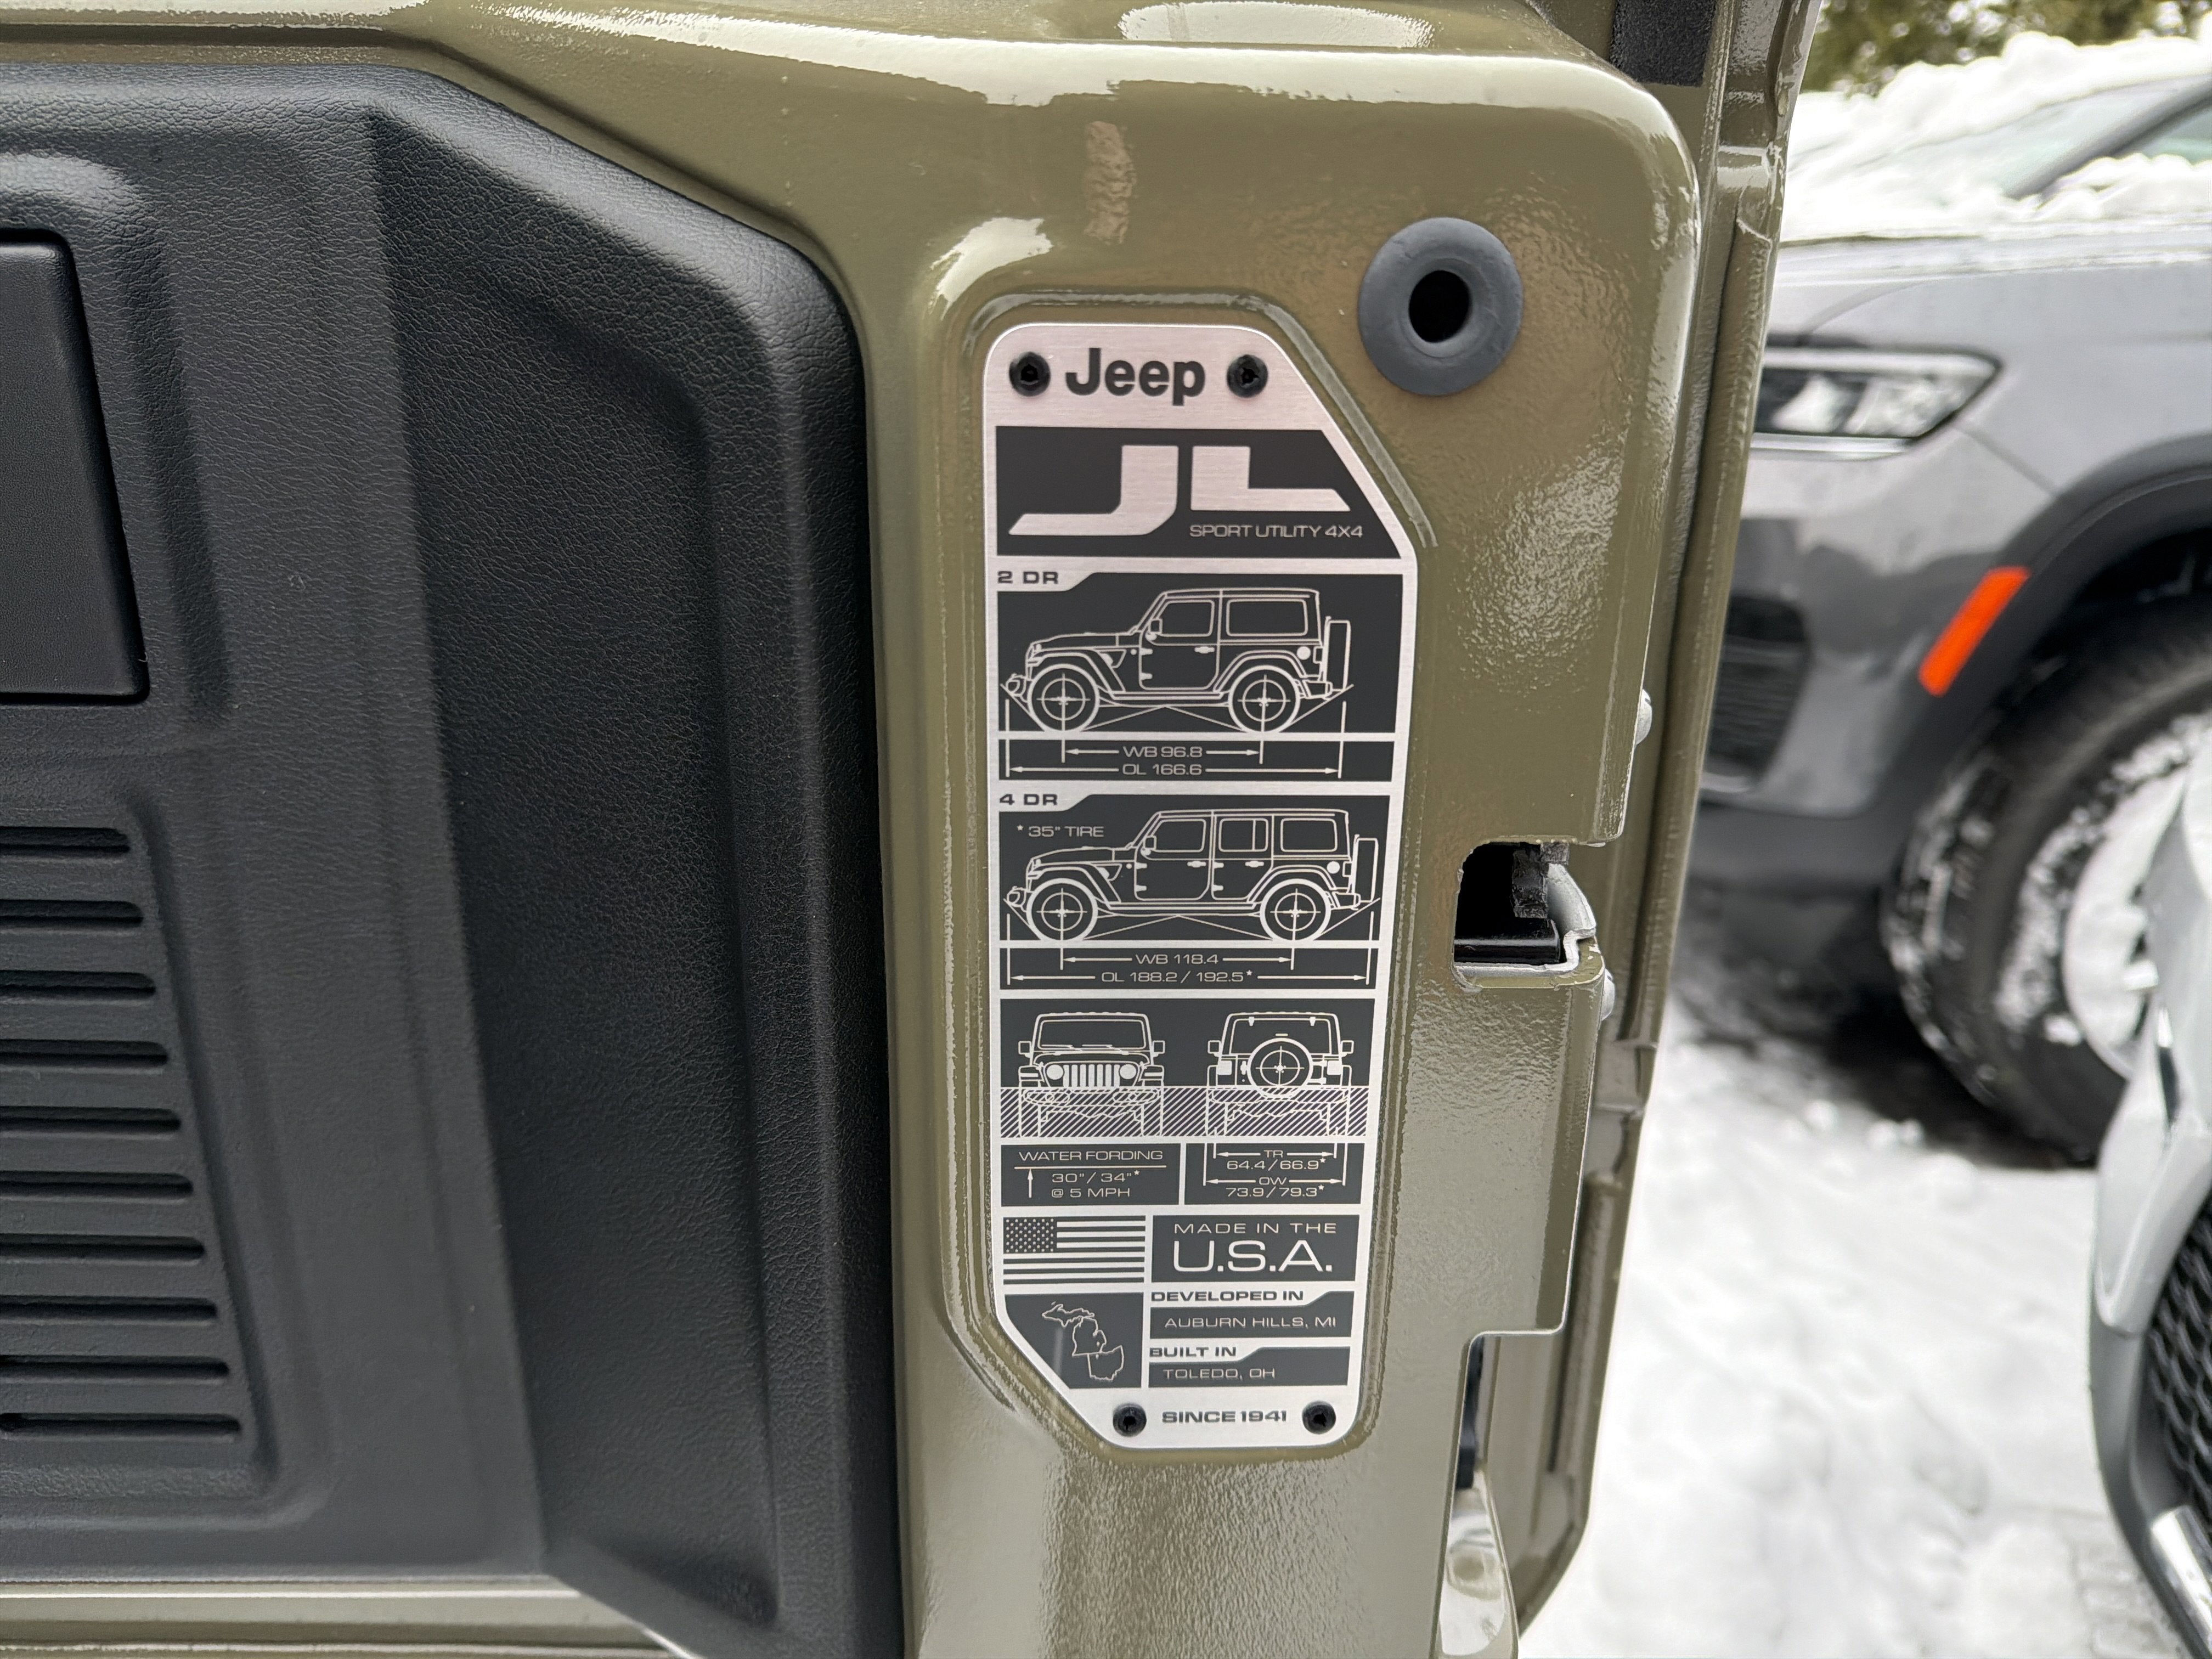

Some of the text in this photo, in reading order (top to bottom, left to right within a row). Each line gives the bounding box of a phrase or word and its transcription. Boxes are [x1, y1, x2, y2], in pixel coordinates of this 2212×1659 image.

[1066, 347, 1206, 406] Jeep
[1008, 445, 1351, 535] JL
[1189, 525, 1363, 538] SPORT UTILITY 4X4
[997, 571, 1058, 584] 2 DR
[1122, 746, 1203, 758] WB 96.8
[1122, 764, 1202, 775] OL 166.6
[1000, 794, 1058, 805] 4 DR
[1065, 826, 1104, 837] TIRE
[1135, 954, 1218, 964] WB 118.4
[1102, 972, 1125, 982] OL
[1018, 1150, 1163, 1161] WATER FORDING
[1259, 1177, 1286, 1185] OW
[1051, 1187, 1130, 1198] @ 5 MPH
[1174, 1222, 1336, 1234] MADE IN THE
[1173, 1240, 1333, 1272] U.S.A.
[1151, 1290, 1304, 1301] DEVELOPED IN
[1164, 1316, 1336, 1329] AUBURN HILLS, MI
[1149, 1346, 1237, 1357] BUILT IN
[1163, 1368, 1274, 1380] TOLEDO, OH
[1161, 1410, 1288, 1423] SINCE 1941
